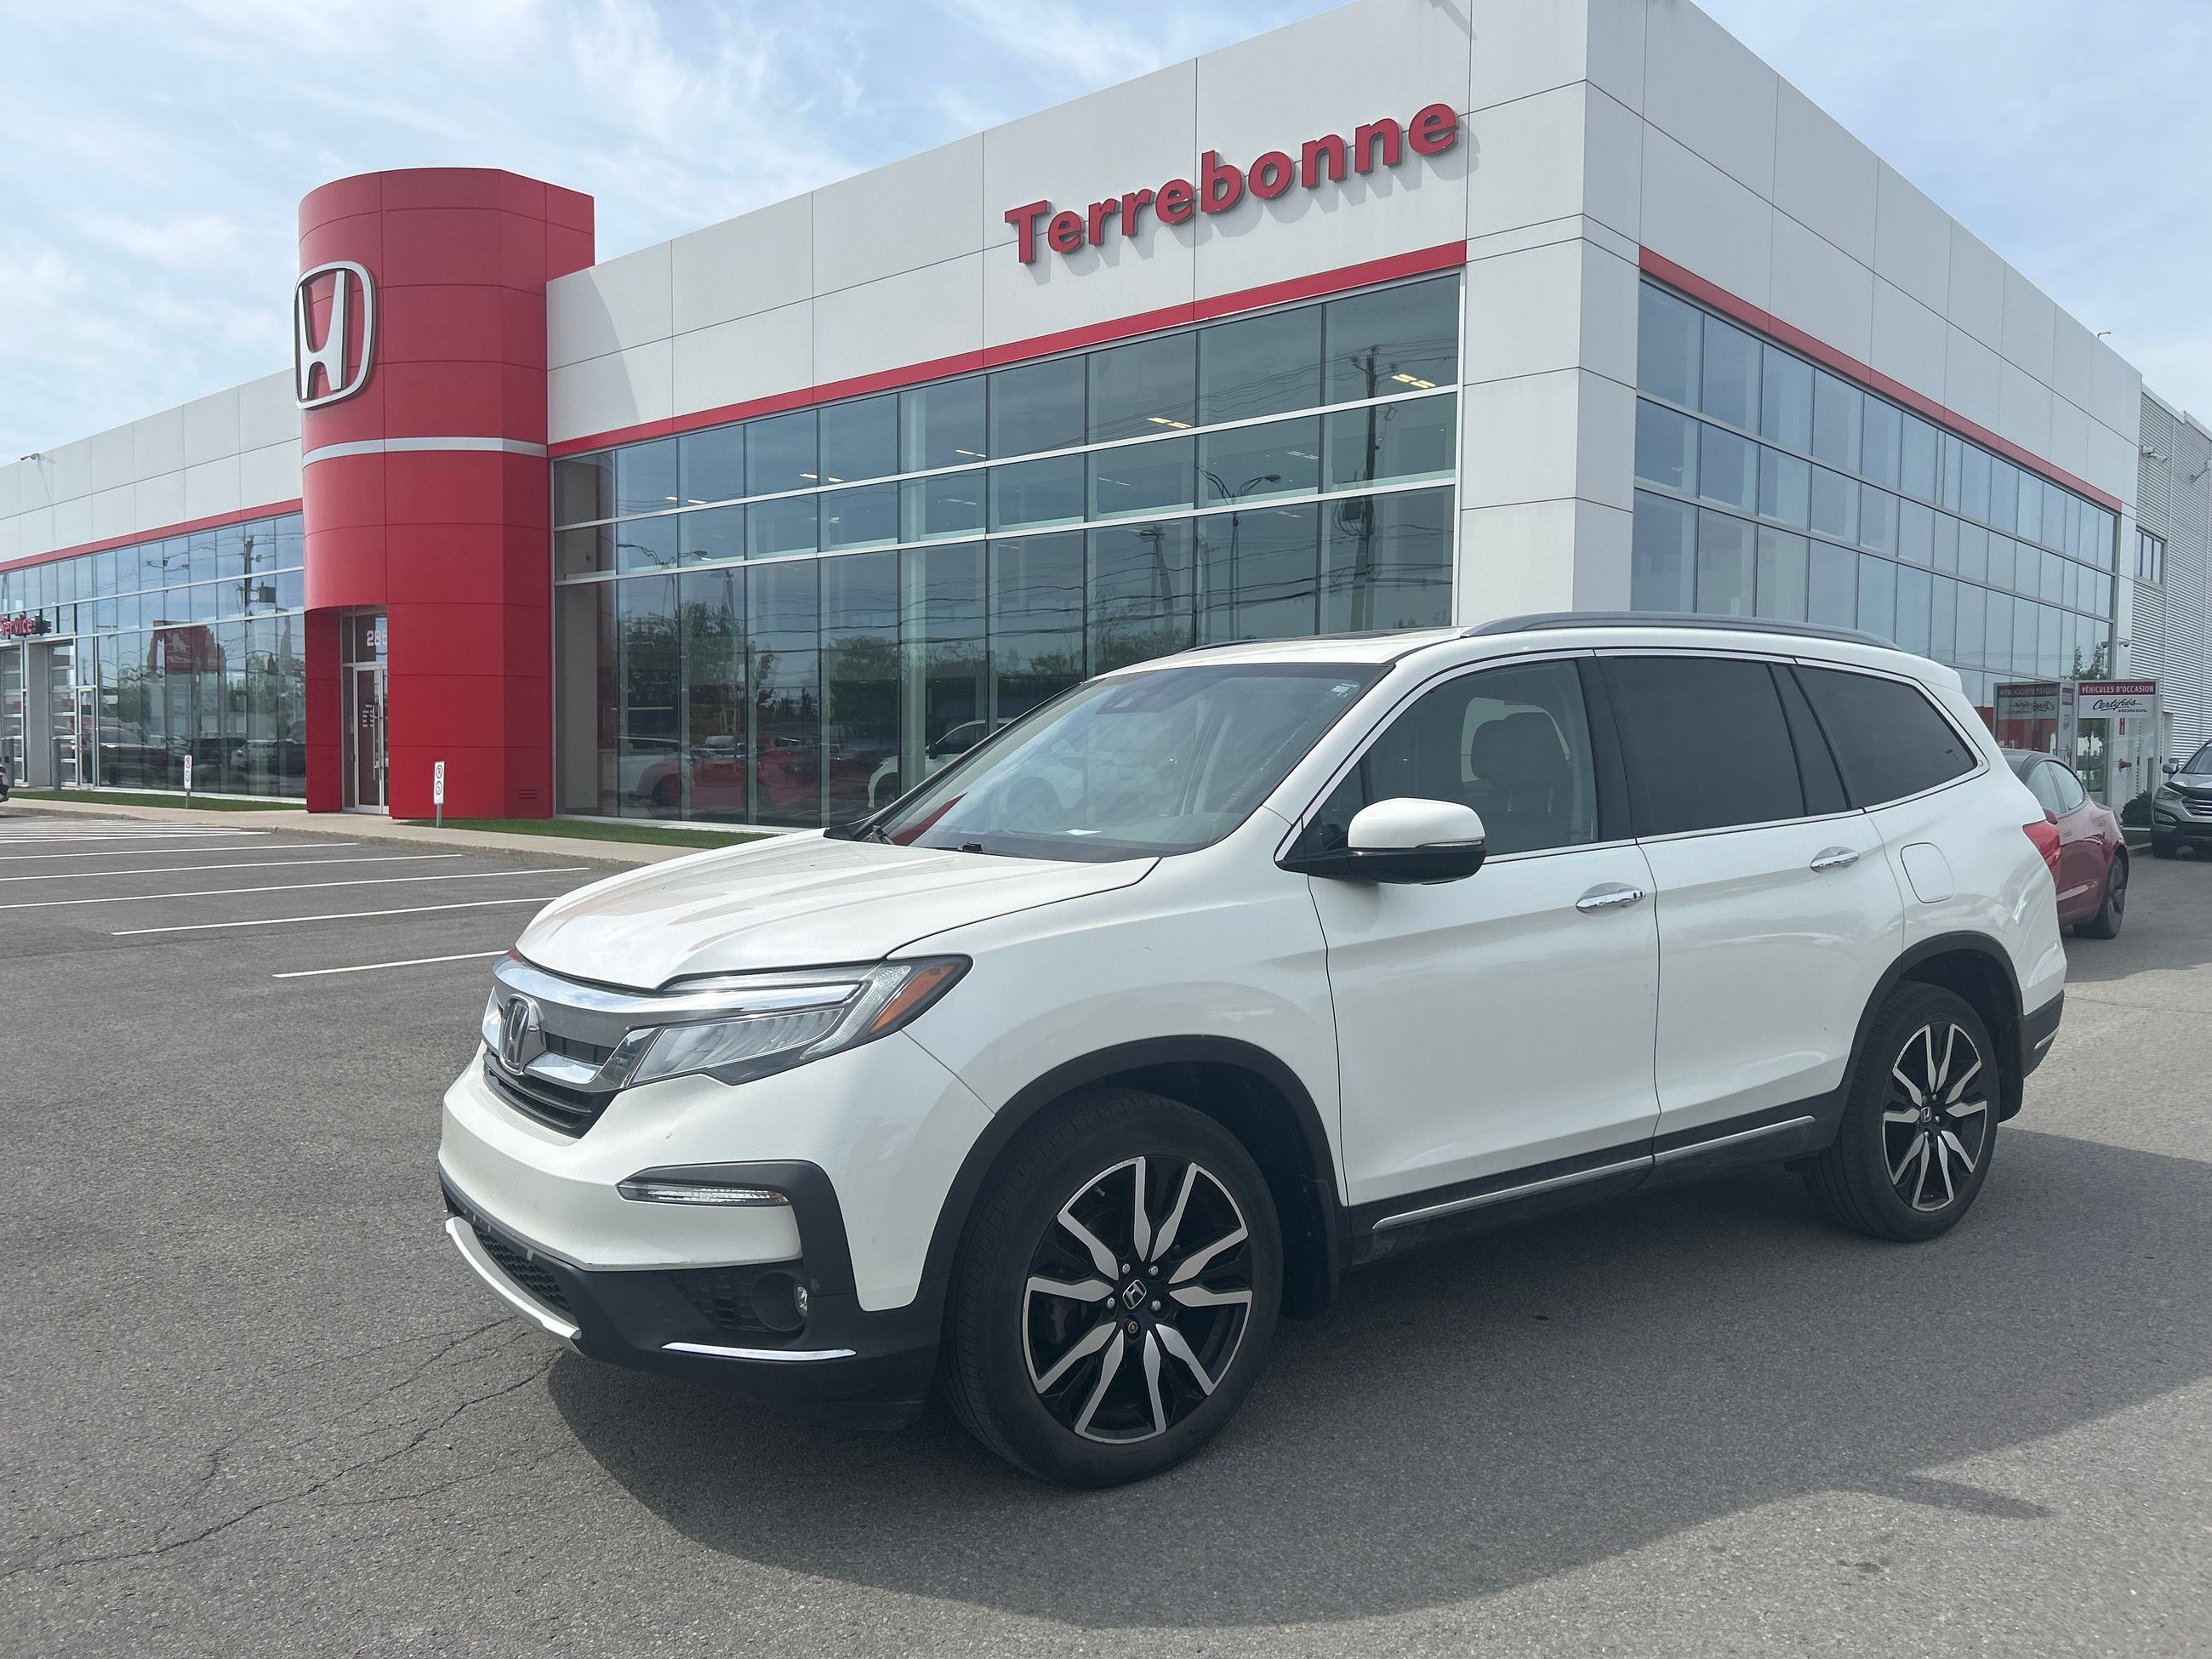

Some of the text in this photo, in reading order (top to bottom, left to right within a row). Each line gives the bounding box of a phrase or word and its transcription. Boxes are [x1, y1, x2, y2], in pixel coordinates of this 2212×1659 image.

[1005, 103, 1460, 265] Terrebonne
[2081, 684, 2154, 693] VÉHICULES D'OCCASION
[2092, 698, 2142, 712] Certifiés
